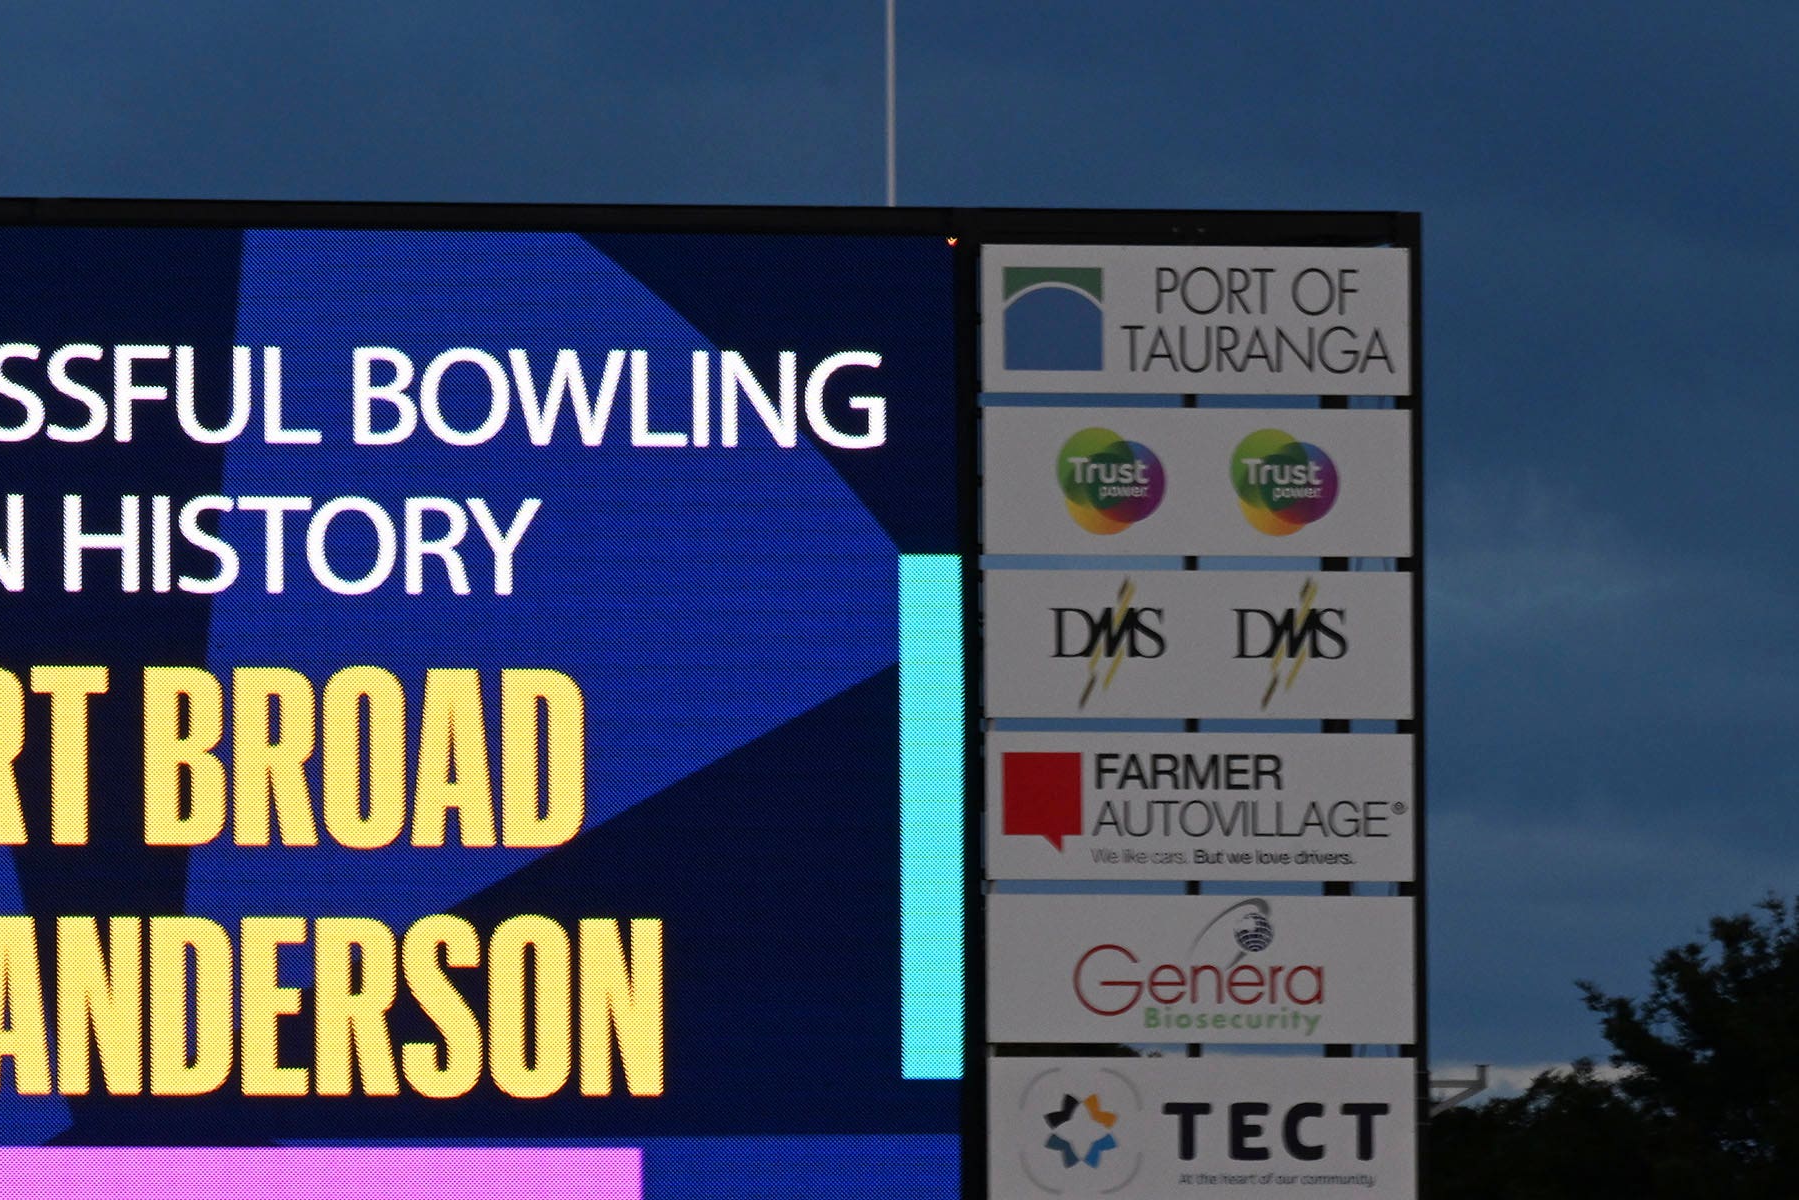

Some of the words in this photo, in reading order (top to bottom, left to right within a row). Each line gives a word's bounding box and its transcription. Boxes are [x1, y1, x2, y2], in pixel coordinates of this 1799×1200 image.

[1157, 267, 1275, 315] PORT
[1292, 268, 1358, 316] OF
[1121, 325, 1394, 374] TAURANGA
[352, 345, 886, 449] BOWLING
[1066, 455, 1149, 483] Trust
[1100, 483, 1149, 498] power
[1240, 457, 1322, 485] Trust
[1273, 484, 1322, 500] power
[64, 495, 543, 596] HISTORY
[1051, 607, 1166, 658] DMS
[1233, 608, 1347, 659] DMS
[144, 665, 584, 848] BROAD
[1096, 753, 1282, 790] FARMER
[1093, 800, 1389, 837] AUTOVILLAGE
[1091, 849, 1120, 864] We
[1123, 849, 1148, 864] like
[1152, 849, 1188, 865] cars.
[1194, 850, 1223, 864] But
[1227, 852, 1253, 865] we
[1256, 851, 1291, 864] love
[1295, 850, 1355, 865] drivers.
[1074, 942, 1323, 1018] Genera
[1144, 1007, 1321, 1036] Biosecurity
[1162, 1102, 1389, 1161] TECT
[1196, 1173, 1217, 1185] the
[1221, 1173, 1257, 1185] heart
[1258, 1172, 1275, 1185] of
[1276, 1175, 1298, 1185] our
